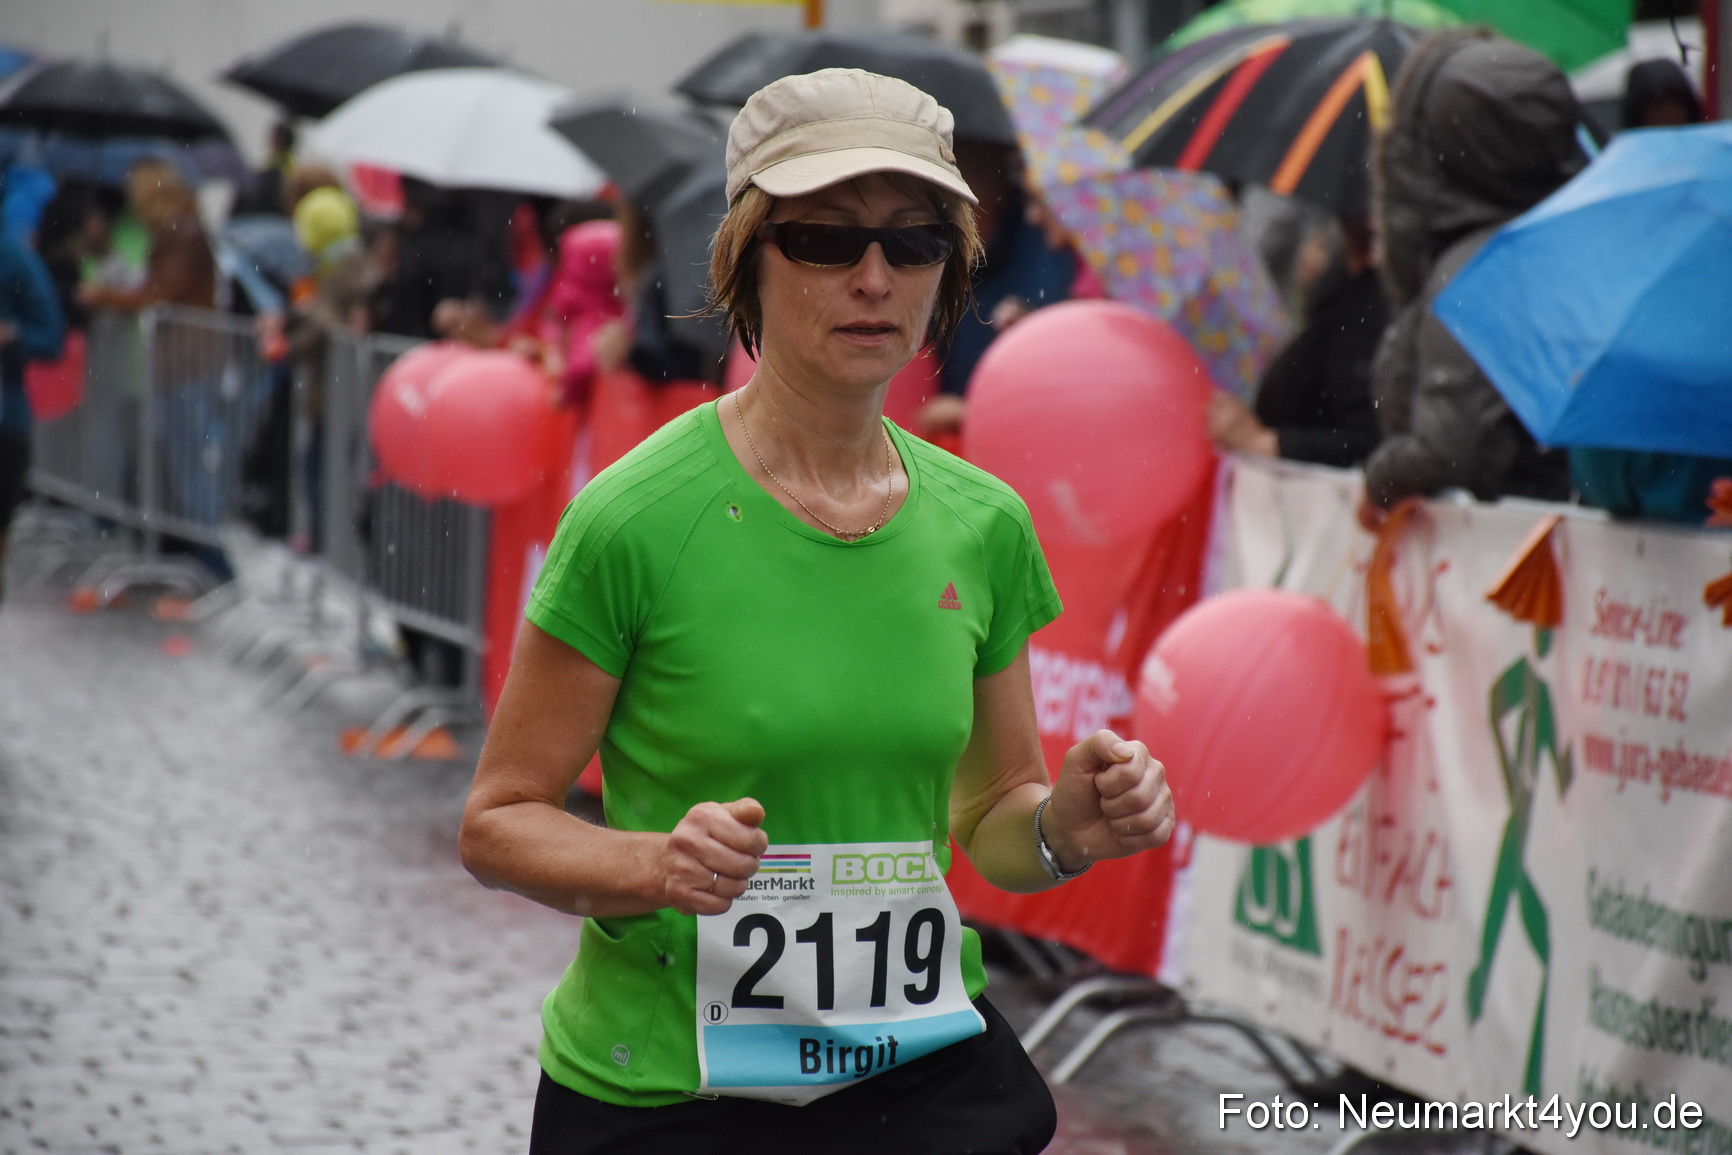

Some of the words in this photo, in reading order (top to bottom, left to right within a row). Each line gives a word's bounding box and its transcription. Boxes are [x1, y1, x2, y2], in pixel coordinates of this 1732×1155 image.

[938, 600, 962, 610] adidas
[761, 894, 779, 902] leben
[782, 894, 811, 902] genießen
[831, 886, 872, 898] inspired
[875, 886, 887, 897] by
[889, 885, 915, 895] smart
[731, 907, 946, 1011] 2119
[710, 1004, 722, 1021] D
[799, 1034, 899, 1079] Birgit
